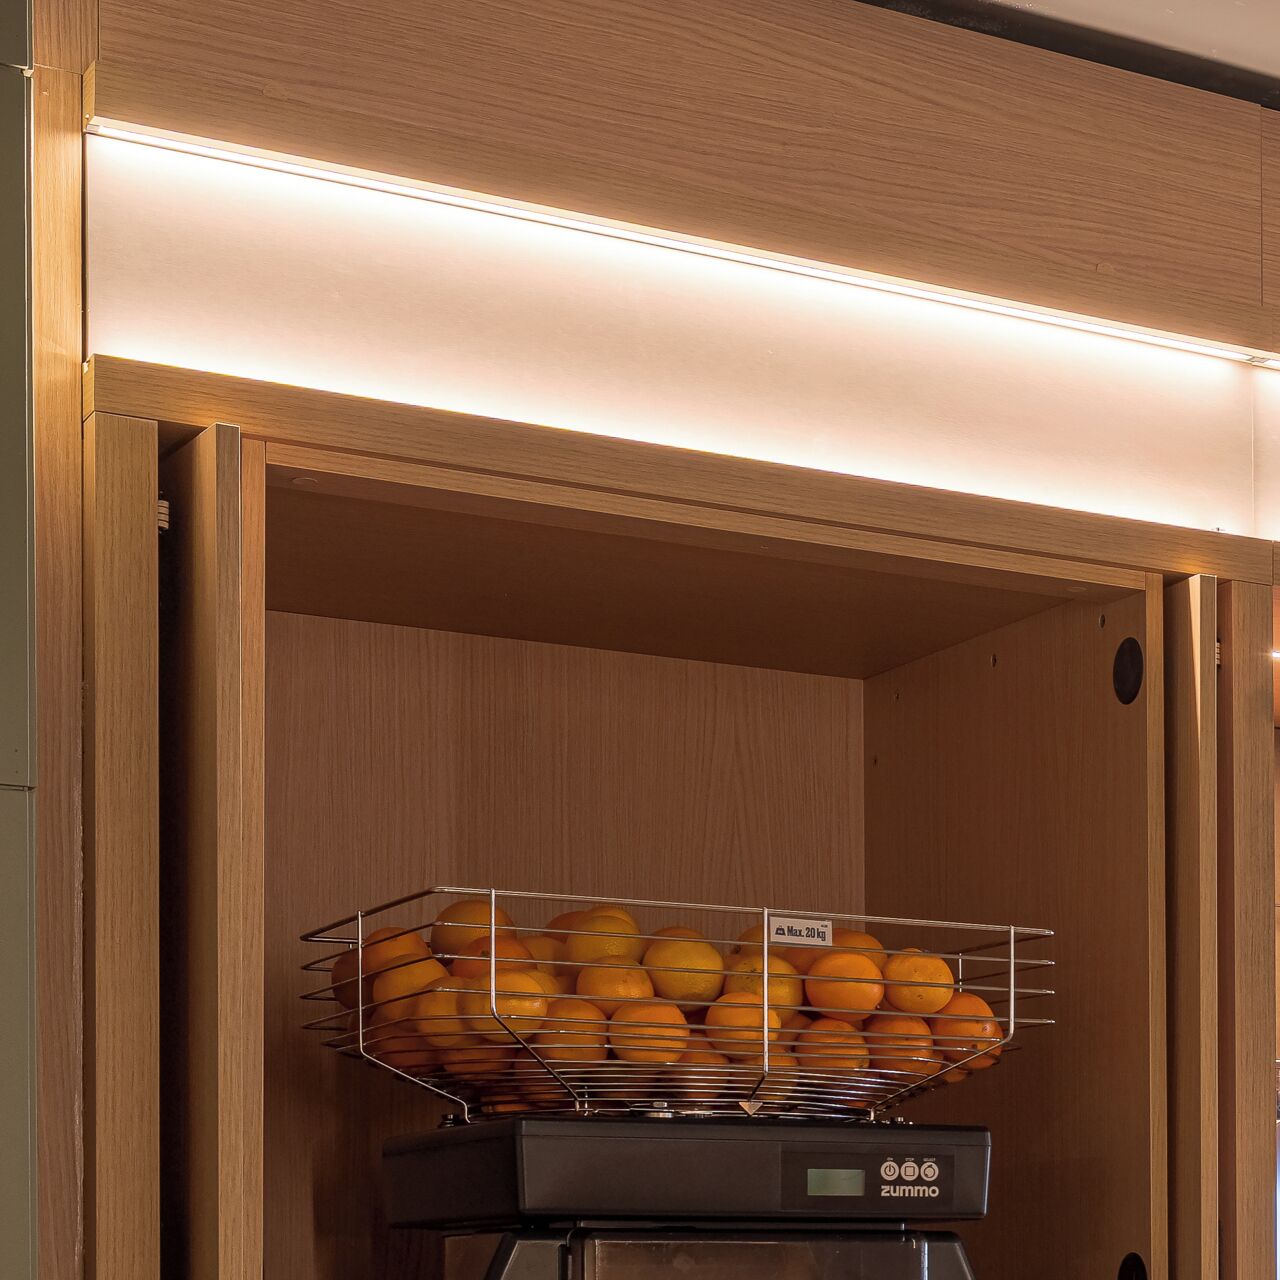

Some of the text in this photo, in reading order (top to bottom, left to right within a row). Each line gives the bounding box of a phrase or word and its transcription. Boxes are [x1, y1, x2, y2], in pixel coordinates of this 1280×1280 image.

[787, 926, 826, 942] Max. 20 kg
[880, 1185, 939, 1197] zummo
